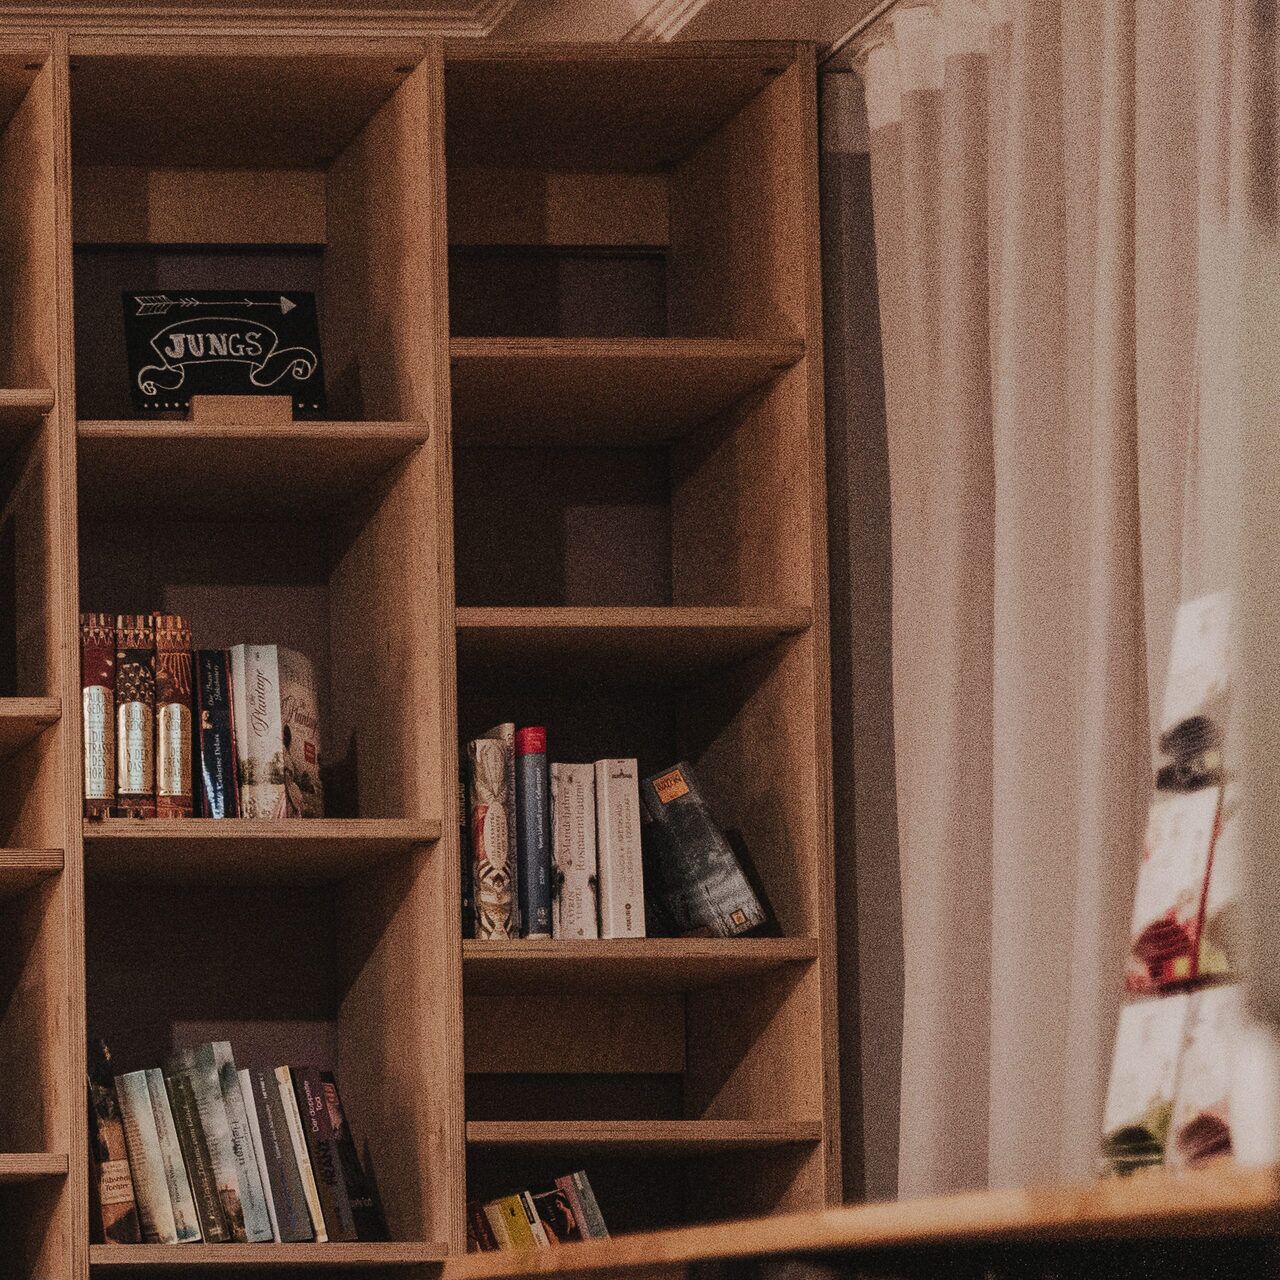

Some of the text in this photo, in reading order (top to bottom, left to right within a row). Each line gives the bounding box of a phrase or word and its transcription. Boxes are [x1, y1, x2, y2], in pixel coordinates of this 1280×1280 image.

[164, 331, 263, 359] JUNGS
[250, 668, 272, 738] Plantage
[302, 1080, 319, 1132] Der doppelte
[314, 1096, 322, 1111] Tod
